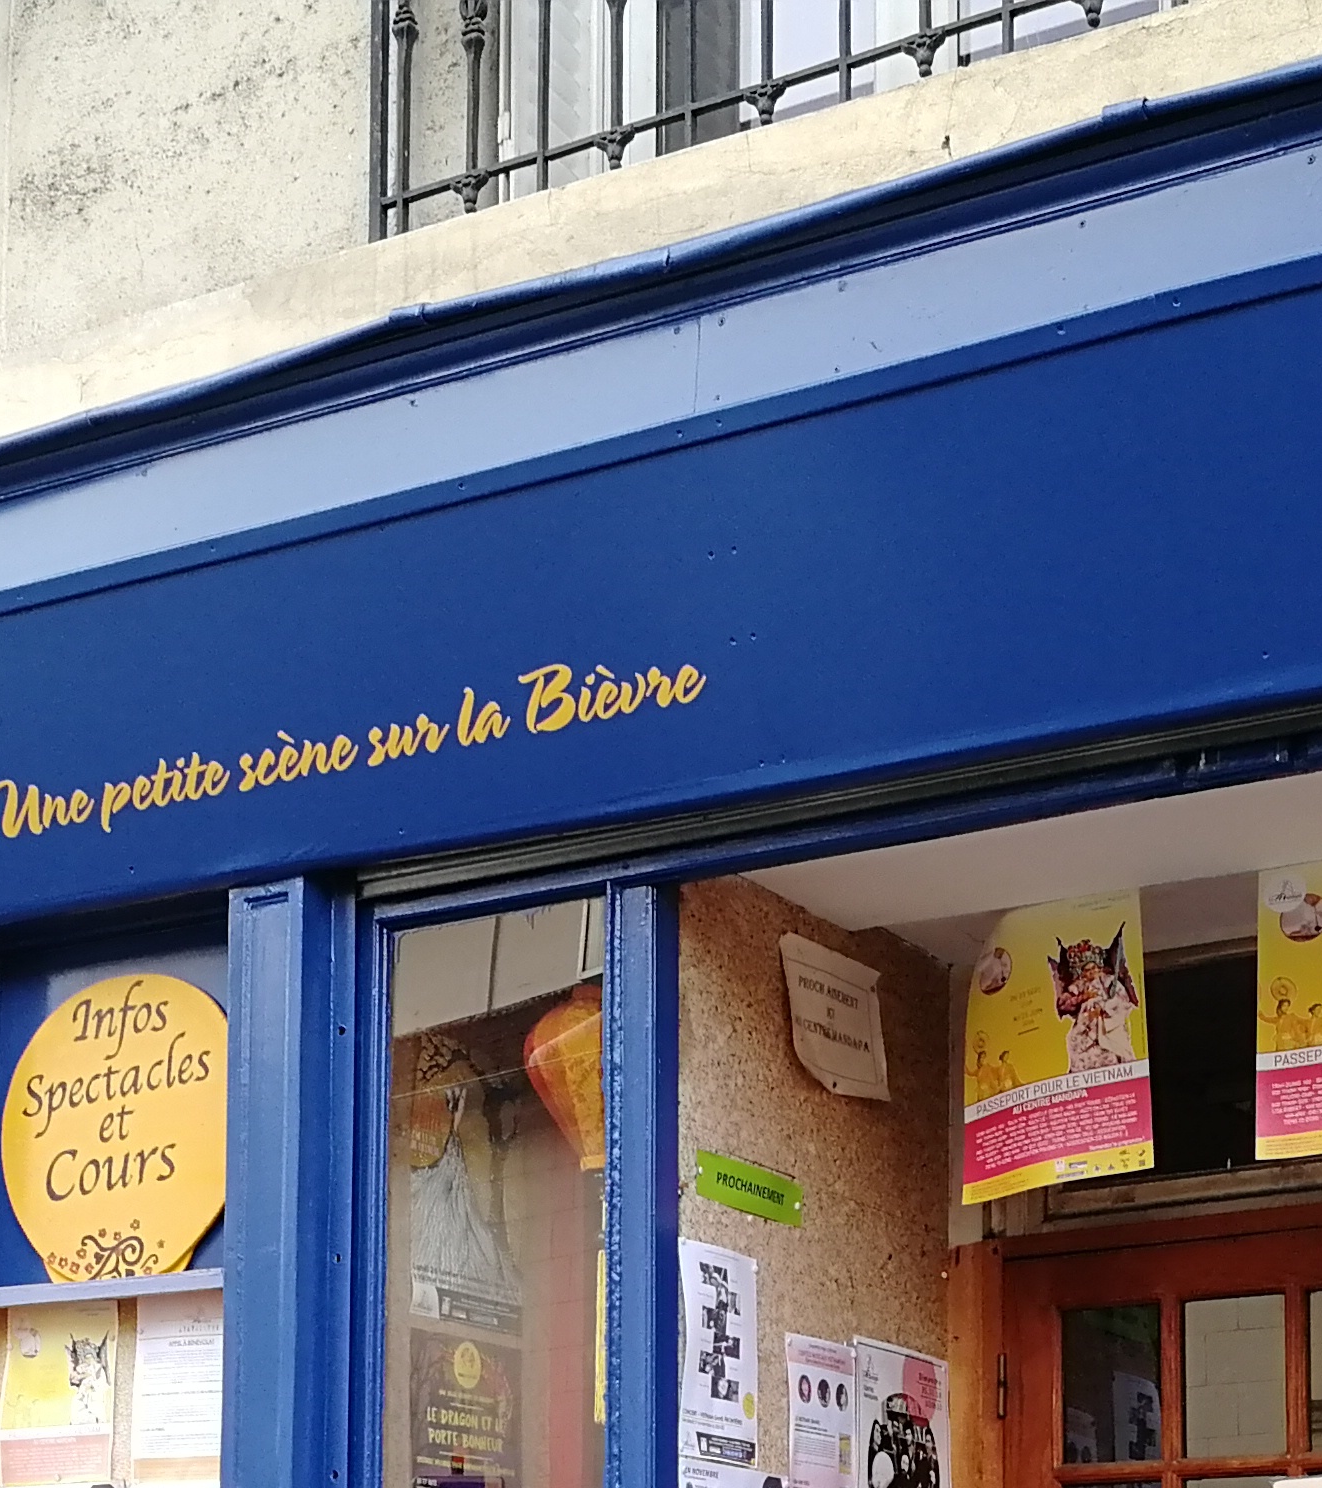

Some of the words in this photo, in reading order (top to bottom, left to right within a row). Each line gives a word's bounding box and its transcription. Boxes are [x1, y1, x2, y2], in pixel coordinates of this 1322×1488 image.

[101, 751, 230, 832] petite
[238, 731, 359, 792] scène
[367, 713, 449, 768] sur
[457, 687, 512, 747] la
[517, 663, 707, 734] Bièvre
[72, 979, 169, 1061] Infos
[22, 1031, 211, 1139] Spectacles
[976, 1088, 1032, 1115] PASSEPORT
[1033, 1080, 1063, 1096] POUR
[1066, 1075, 1080, 1089] LE
[1082, 1065, 1133, 1084] VIETNAM
[1012, 1104, 1022, 1115] AU
[1023, 1096, 1051, 1112] CENTRE
[1051, 1089, 1088, 1103] MANDAPA
[98, 1105, 134, 1143] et
[45, 1143, 177, 1201] Cours
[716, 1171, 785, 1206] PROCHAINEMENT
[427, 1406, 438, 1422] LE
[441, 1408, 478, 1430] DRAGON
[427, 1427, 458, 1446] PORTE
[462, 1433, 504, 1453] BONHEUR
[692, 1467, 719, 1479] NOVEMBRE
